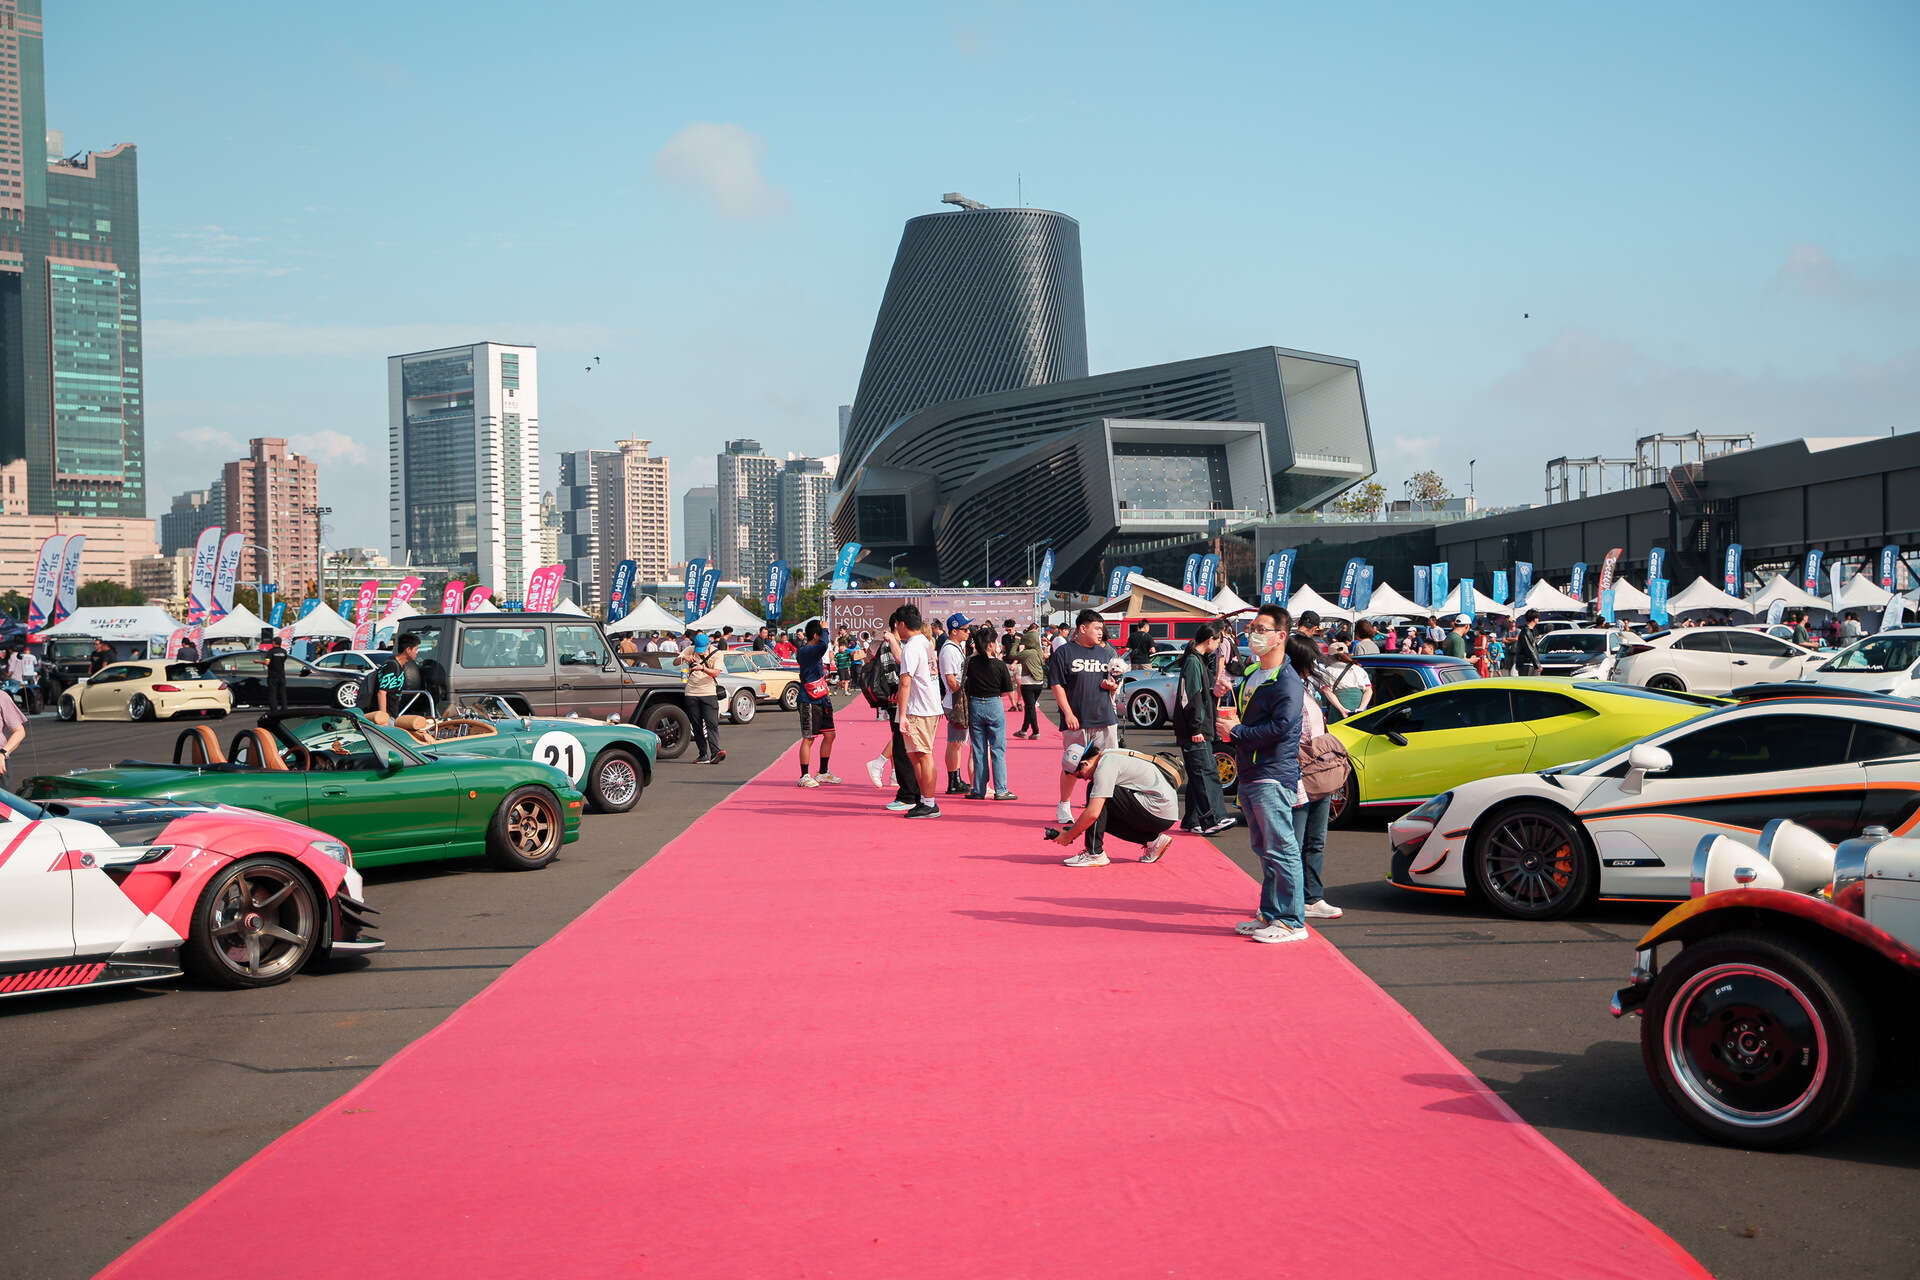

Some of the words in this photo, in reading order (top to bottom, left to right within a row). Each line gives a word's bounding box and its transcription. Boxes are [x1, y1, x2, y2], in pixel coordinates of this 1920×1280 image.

[834, 605, 864, 617] KAO
[835, 617, 884, 630] HSIUNG
[1071, 658, 1109, 673] Stitc
[544, 744, 574, 778] 21
